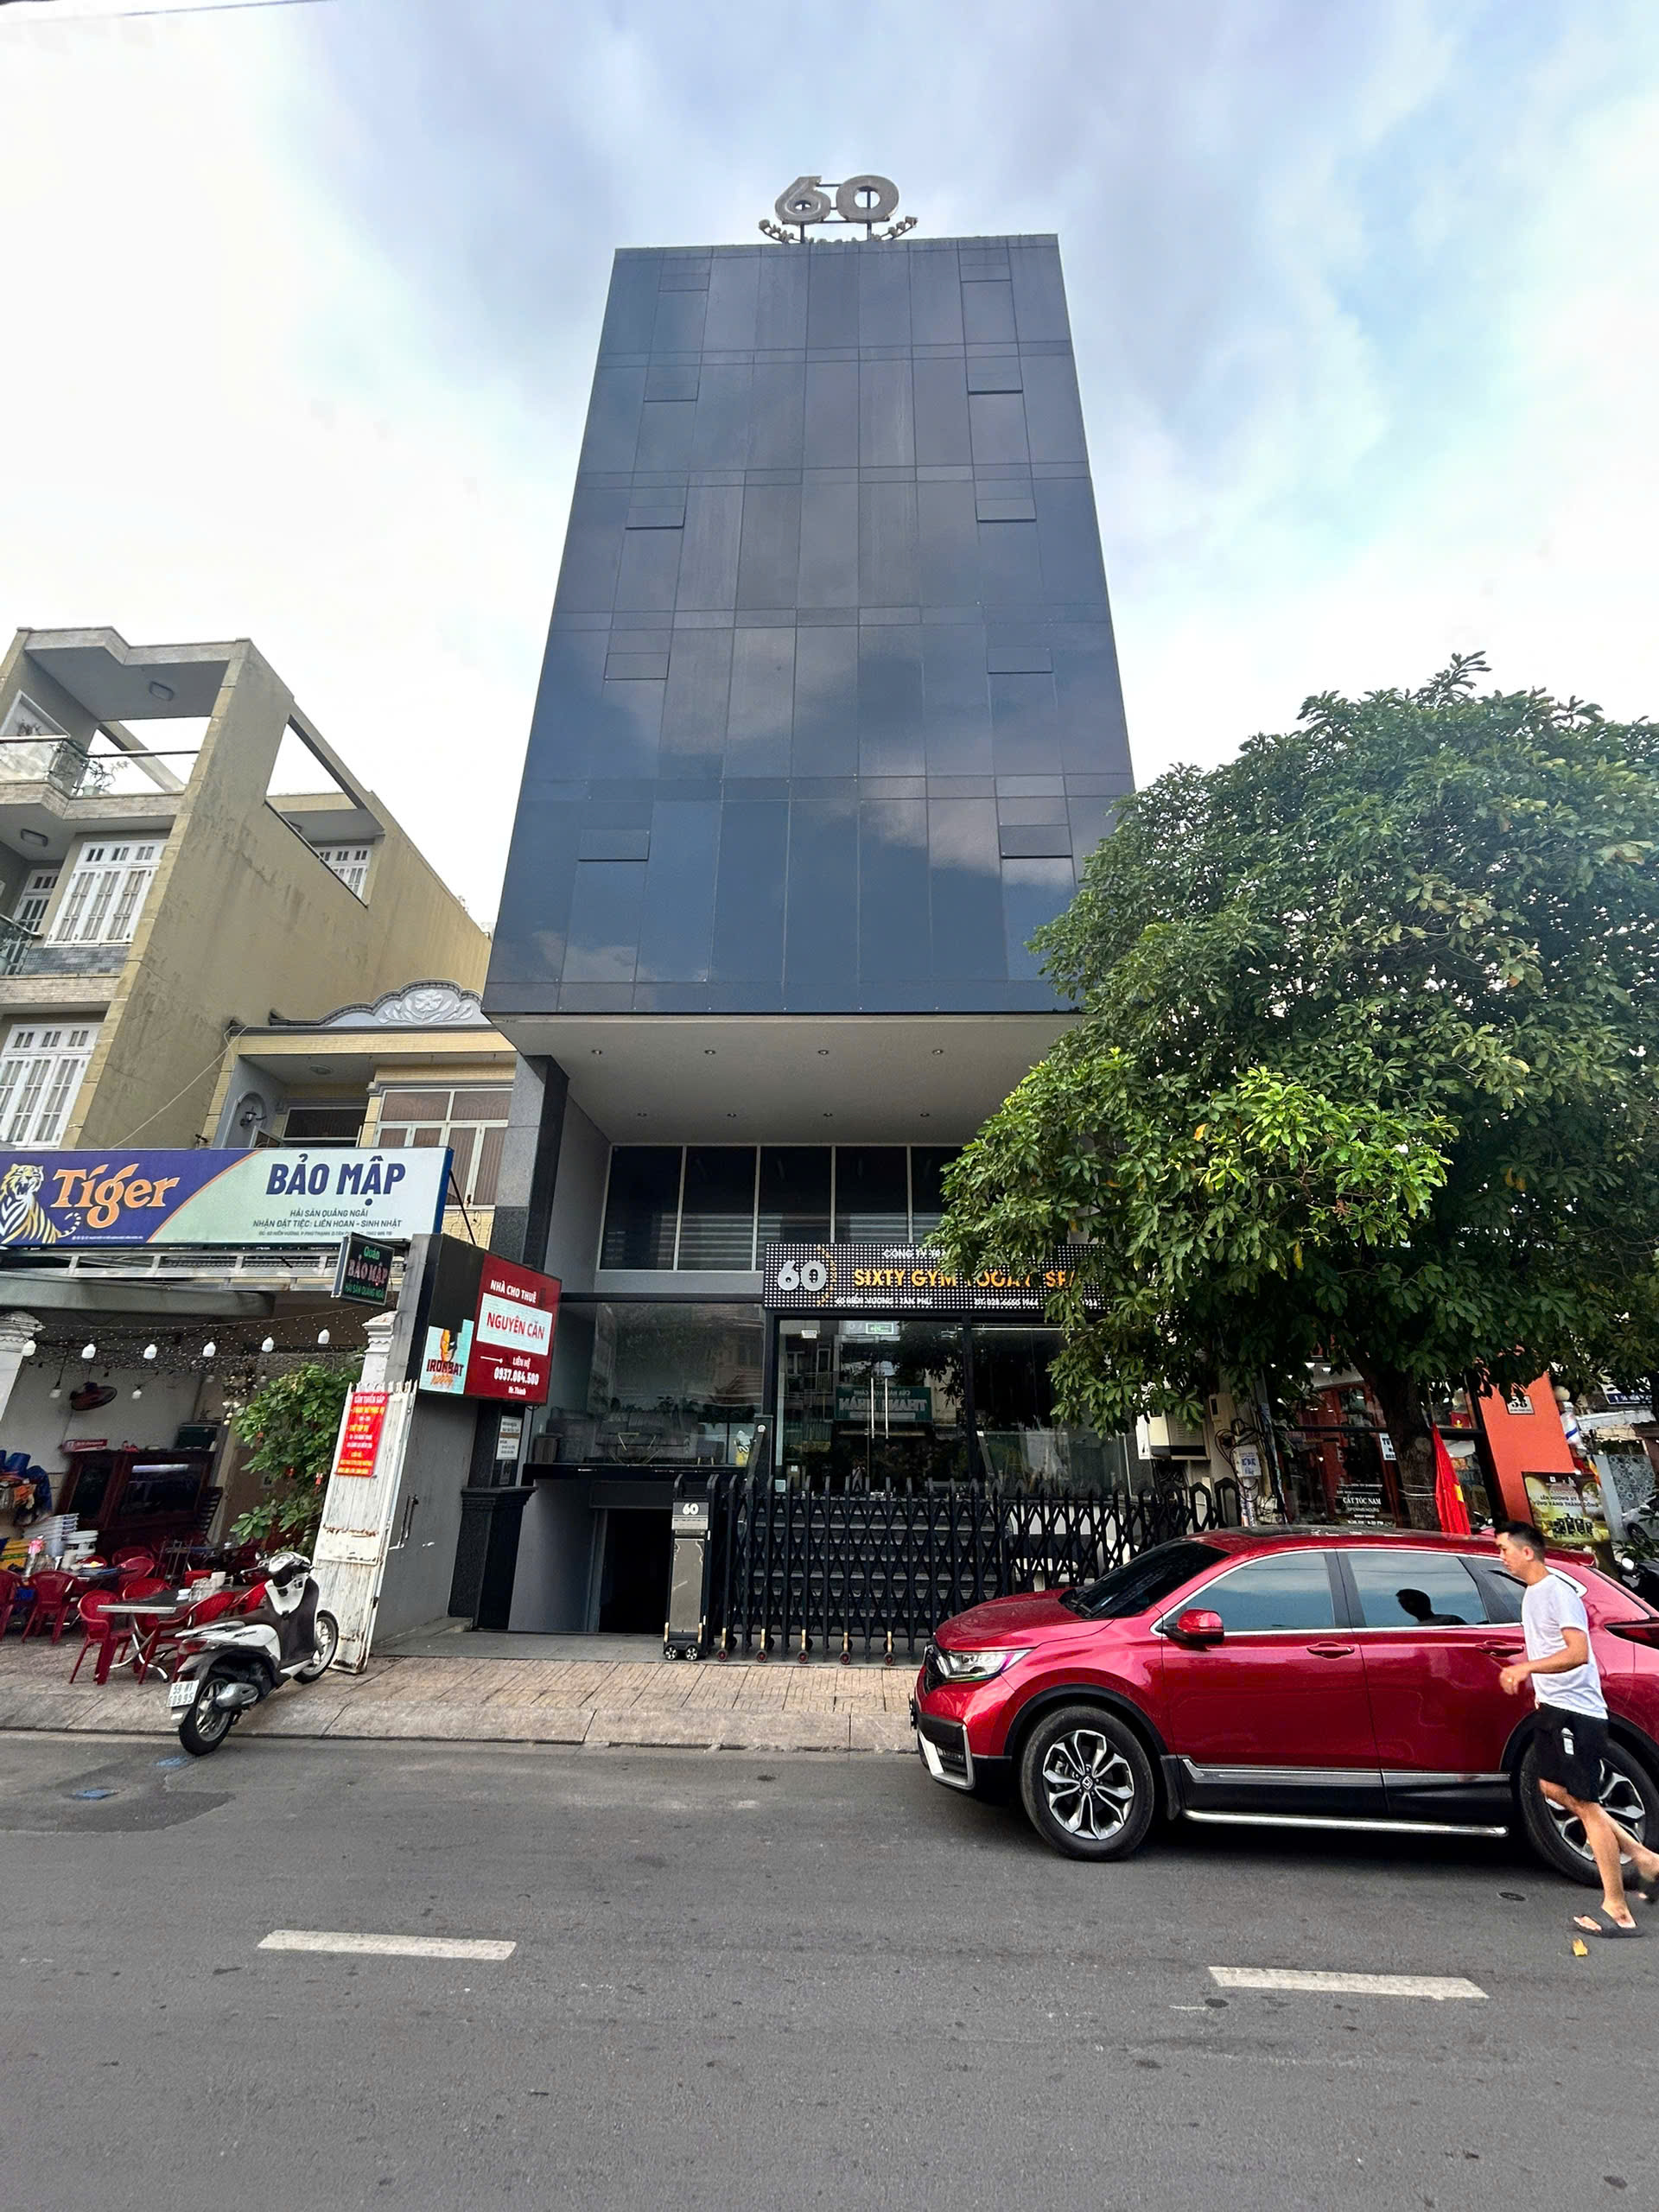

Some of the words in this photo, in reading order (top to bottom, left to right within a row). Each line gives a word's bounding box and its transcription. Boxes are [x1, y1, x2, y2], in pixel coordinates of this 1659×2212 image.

[775, 175, 899, 225] 60
[266, 1154, 330, 1195] BẢO
[336, 1155, 405, 1206] MẬP
[50, 1163, 181, 1229] Tiger
[290, 1209, 304, 1217] HẢI
[322, 1209, 347, 1217] QUẢNG
[314, 1219, 332, 1228] LIÊN
[364, 1246, 380, 1260] Quán
[347, 1254, 368, 1279] BẢO
[368, 1262, 388, 1287] MẬP
[778, 1260, 827, 1291] 60
[855, 1268, 906, 1287] SIXTY
[911, 1268, 957, 1287] GYM
[490, 1280, 505, 1294] NHÀ
[506, 1285, 520, 1298] CHO
[521, 1290, 537, 1303] THUÊ
[486, 1312, 526, 1335] NGUYÊN
[526, 1320, 545, 1339] CĂN
[683, 1503, 699, 1515] 60
